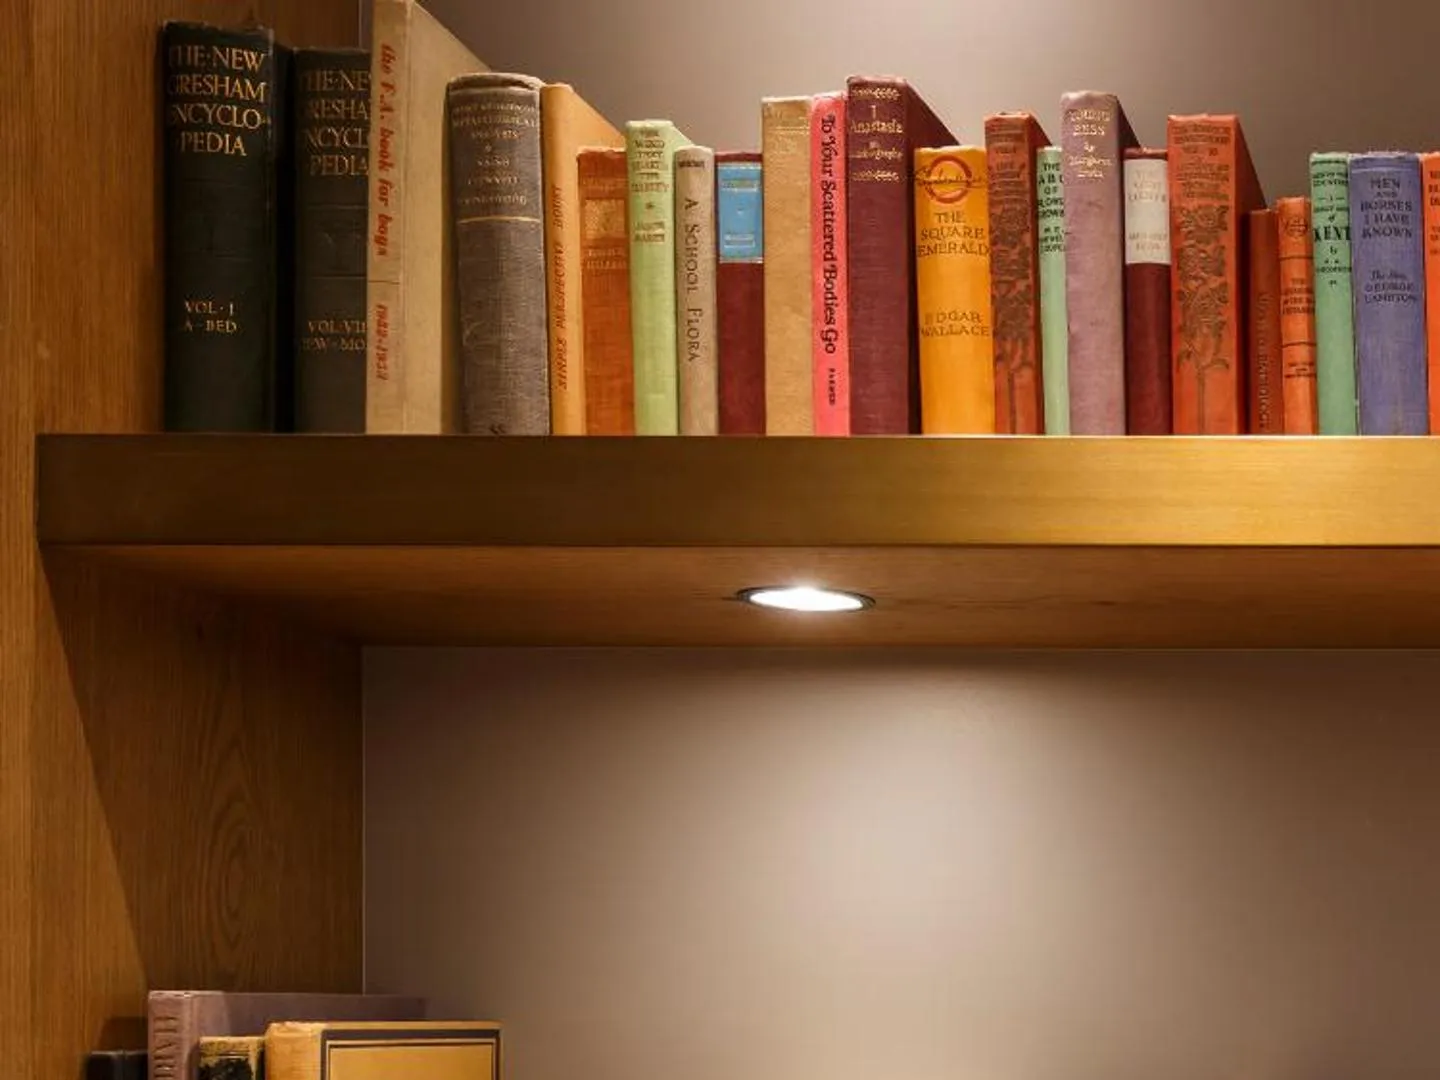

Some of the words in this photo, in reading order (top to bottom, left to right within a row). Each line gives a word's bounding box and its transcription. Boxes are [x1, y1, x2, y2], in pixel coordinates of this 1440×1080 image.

[380, 43, 397, 76] the
[820, 114, 836, 132] To
[181, 131, 247, 156] PEDIA
[377, 125, 395, 172] book
[820, 134, 837, 178] Your
[377, 176, 393, 208] for
[1370, 178, 1400, 190] MEN
[684, 198, 700, 211] A
[1360, 201, 1413, 213] HORSES
[820, 180, 836, 260] Scattered
[934, 211, 964, 224] THE
[1375, 213, 1409, 225] HAVE
[374, 214, 393, 257] boys
[920, 226, 985, 241] SQUARE
[1361, 226, 1413, 239] KNOWN
[684, 223, 700, 295] SCHOOL
[917, 243, 989, 257] EMERALD
[820, 262, 839, 326] Bodies
[925, 312, 983, 324] EDGAR
[686, 307, 703, 362] FLORA
[820, 329, 836, 354] Go
[921, 325, 990, 339] WALLACE
